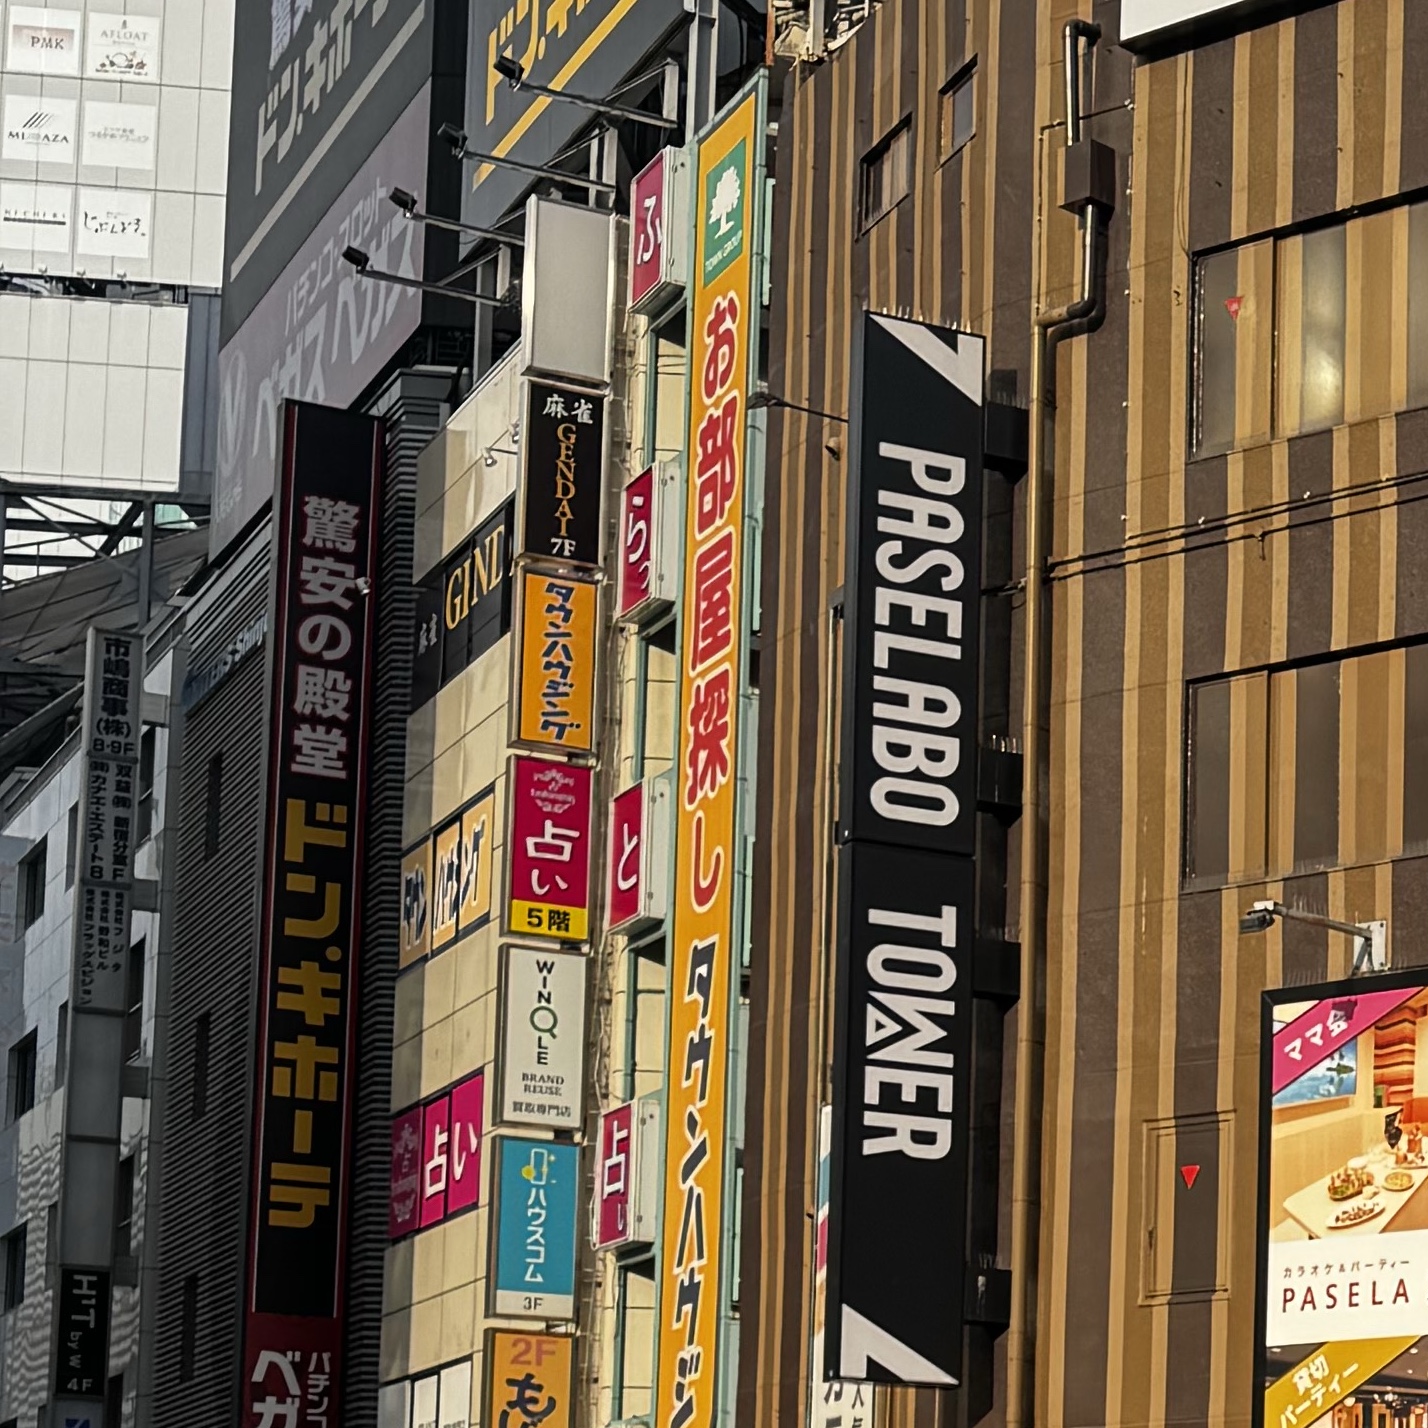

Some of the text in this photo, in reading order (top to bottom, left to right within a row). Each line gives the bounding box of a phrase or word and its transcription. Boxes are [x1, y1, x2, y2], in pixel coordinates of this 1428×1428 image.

[31, 36, 64, 50] PMK
[635, 195, 664, 266] ふ
[543, 394, 593, 425] 麻雀
[555, 424, 575, 537] GENDAI
[550, 538, 576, 557] 7F
[686, 290, 740, 912] お部屋探し
[290, 495, 360, 780] 驚安の殿堂
[540, 582, 582, 740] タウンハウジング
[861, 441, 967, 1160] PASELABO TOWER
[526, 819, 580, 895] 占い
[617, 823, 640, 893] と
[527, 907, 571, 932] 5階
[1283, 1009, 1349, 1062] ママ会
[521, 1073, 565, 1085] BRAND
[523, 1085, 563, 1097] REUSE
[425, 1121, 479, 1198] 占い
[523, 1184, 546, 1282] ハウスコム
[523, 1297, 543, 1311] 3F
[1281, 1278, 1410, 1313] PASELA
[510, 1338, 558, 1366] 2F
[1292, 1353, 1330, 1397] 貸切
[67, 1378, 93, 1391] 4F
